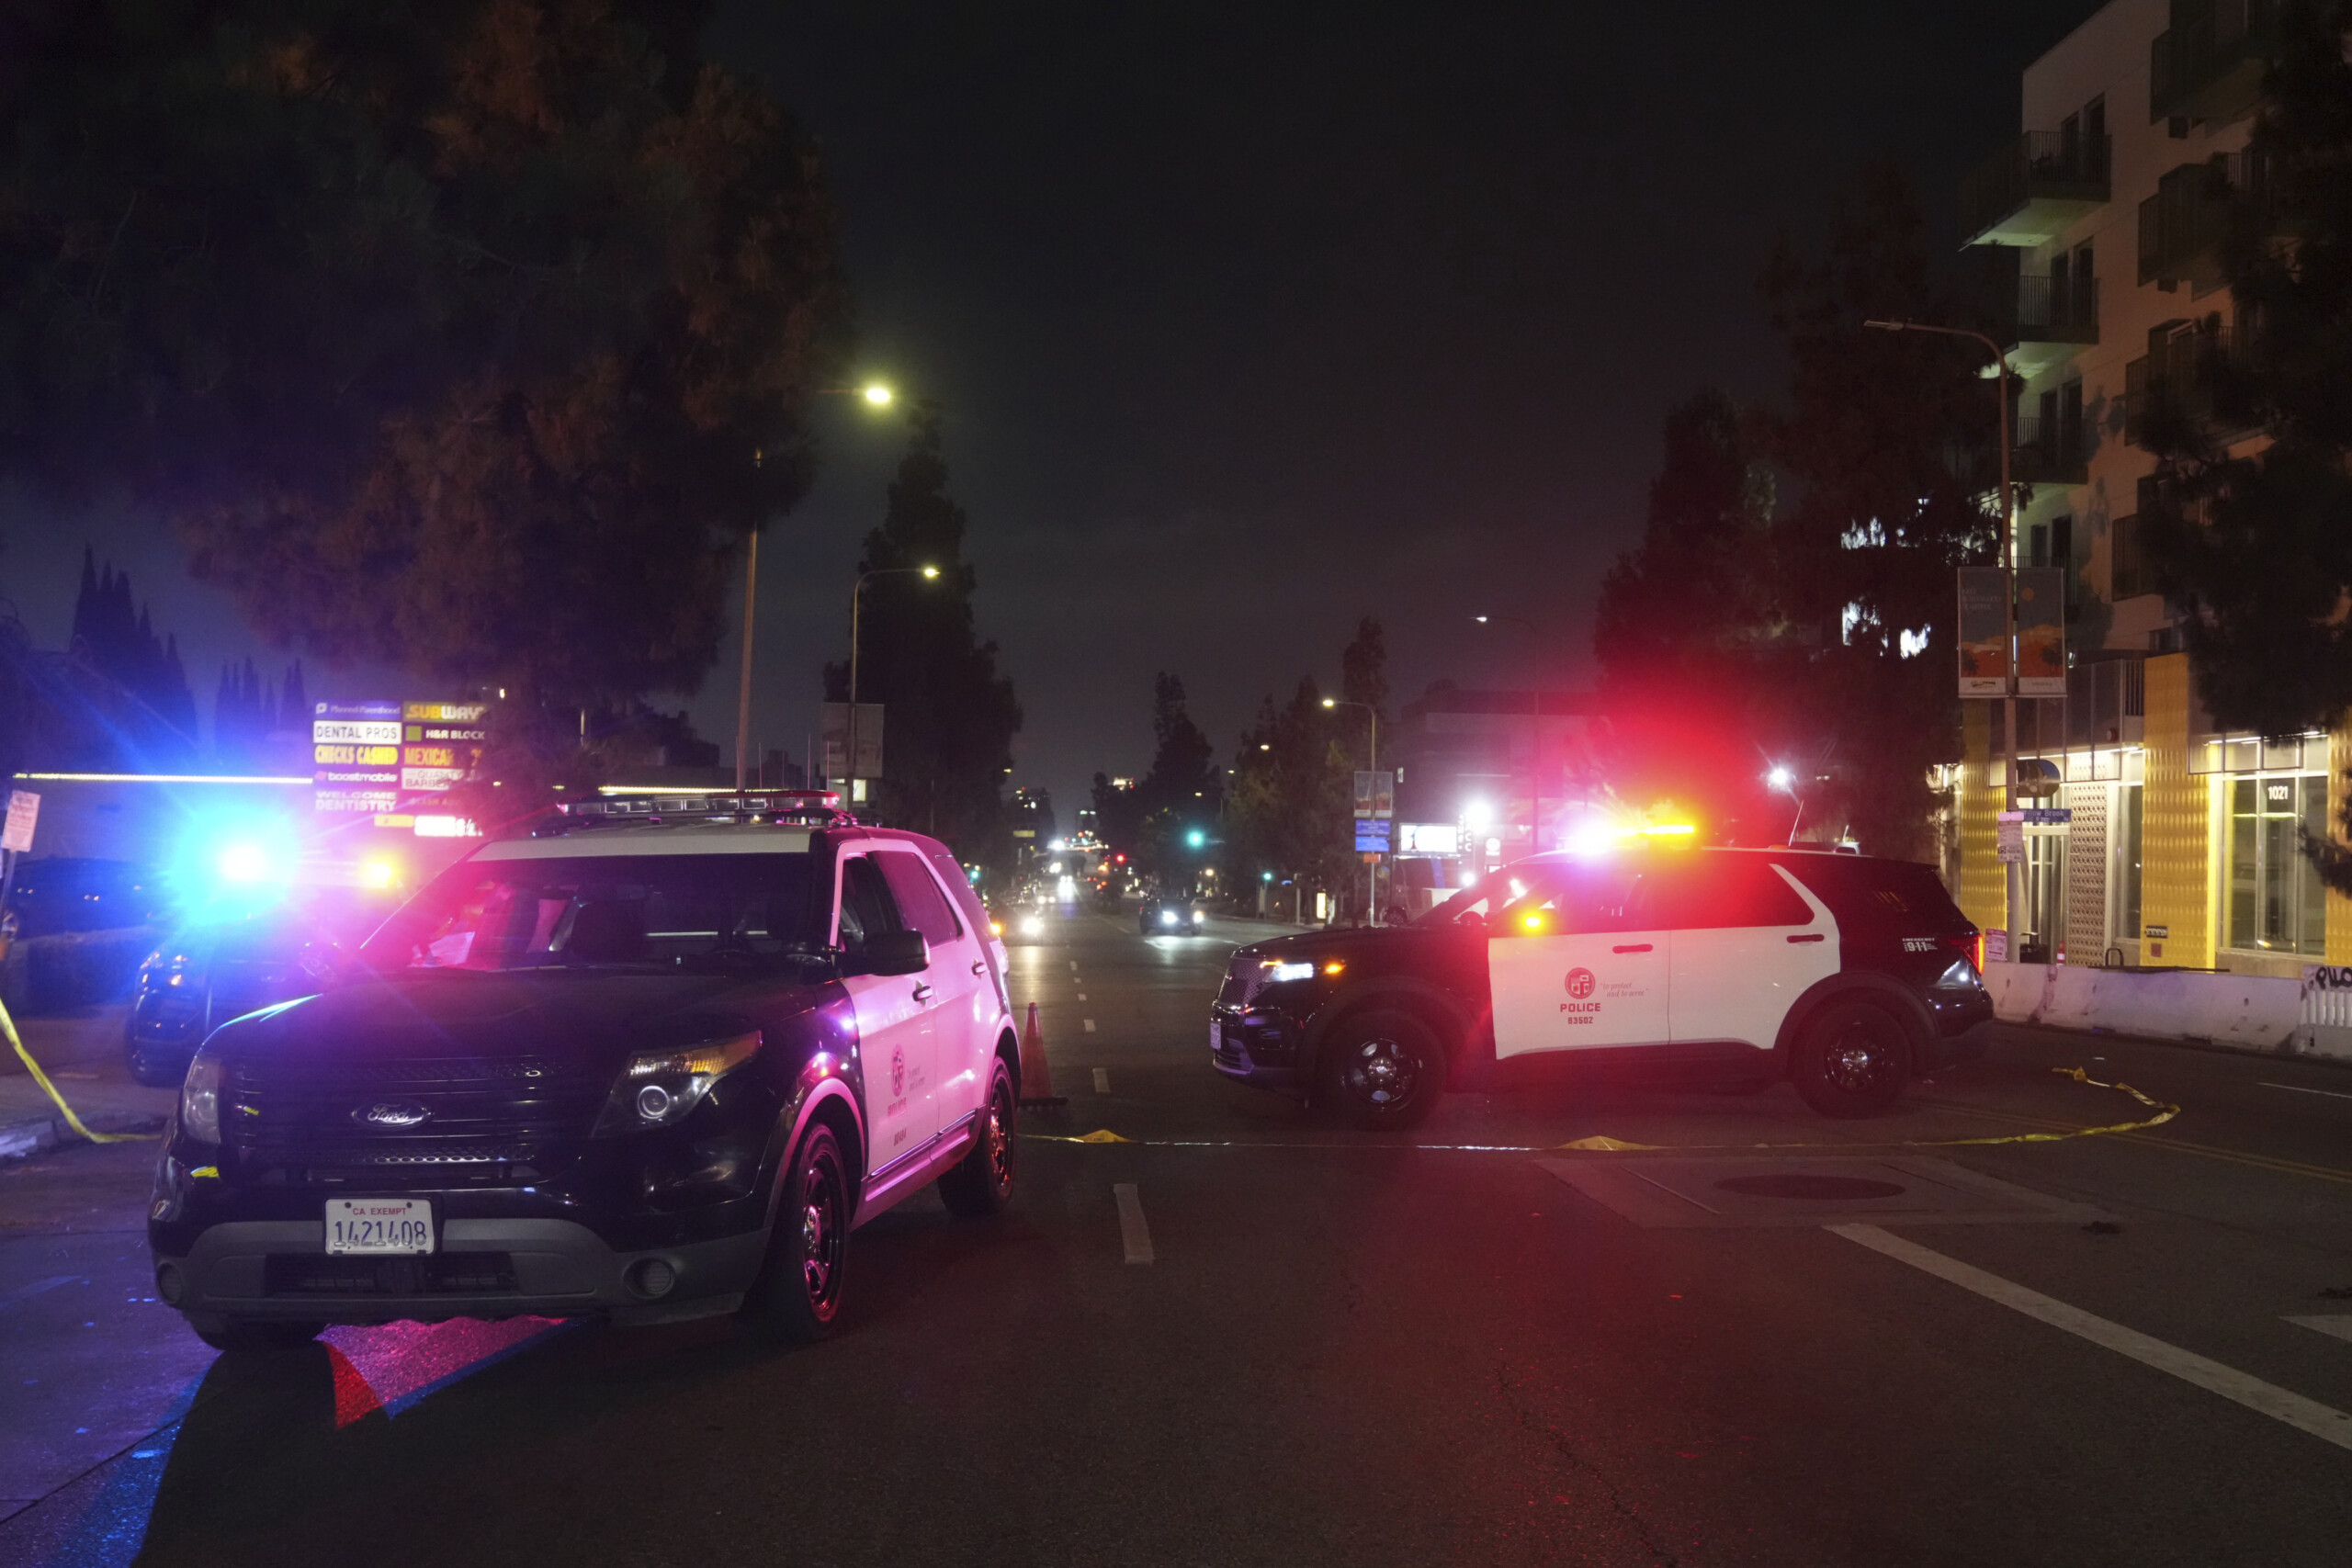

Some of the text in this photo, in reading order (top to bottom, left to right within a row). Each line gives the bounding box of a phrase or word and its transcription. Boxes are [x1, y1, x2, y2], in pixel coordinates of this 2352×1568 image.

[406, 705, 484, 720] SUBWAY
[316, 726, 397, 739] DENTAL PROS
[425, 729, 485, 739] H&R BLOCK
[315, 745, 398, 765] CHECKS CASHED
[316, 791, 397, 799] WELCOME
[2267, 785, 2289, 800] 1021
[315, 799, 396, 811] DENTISTRY
[1560, 1002, 1600, 1012] POLICE
[368, 1103, 411, 1122] Ford
[353, 1207, 407, 1215] CA EXEMPT
[334, 1220, 427, 1247] 1421408
